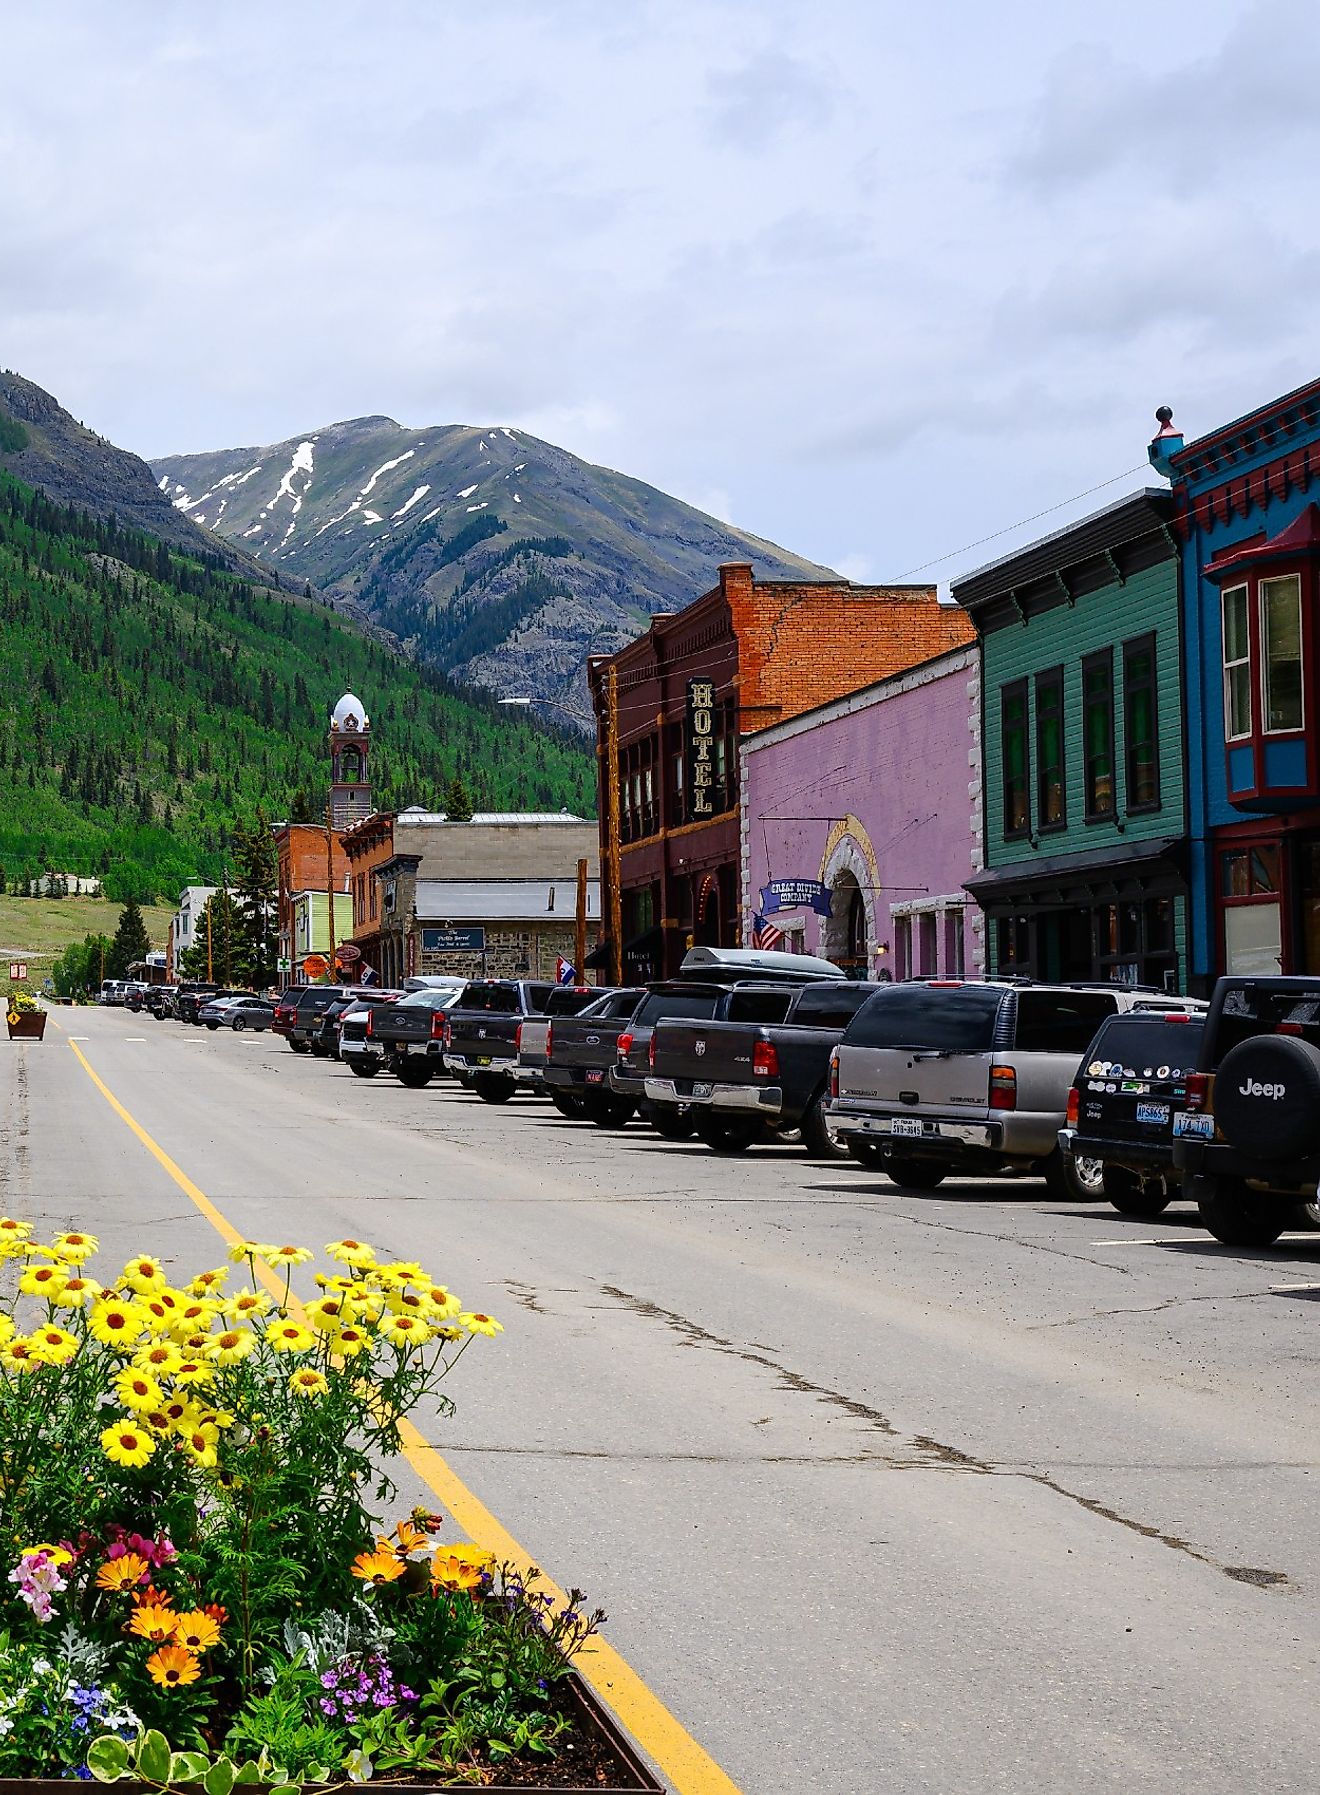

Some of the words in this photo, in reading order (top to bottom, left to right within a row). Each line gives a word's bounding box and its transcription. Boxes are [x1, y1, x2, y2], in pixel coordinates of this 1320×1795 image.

[691, 683, 713, 813] HOTEL
[771, 883, 795, 894] GREAT
[796, 883, 821, 895] DIVIDE
[780, 893, 813, 903] COMPANY
[1239, 1078, 1286, 1100] Jeep
[1086, 1109, 1102, 1119] Jeep
